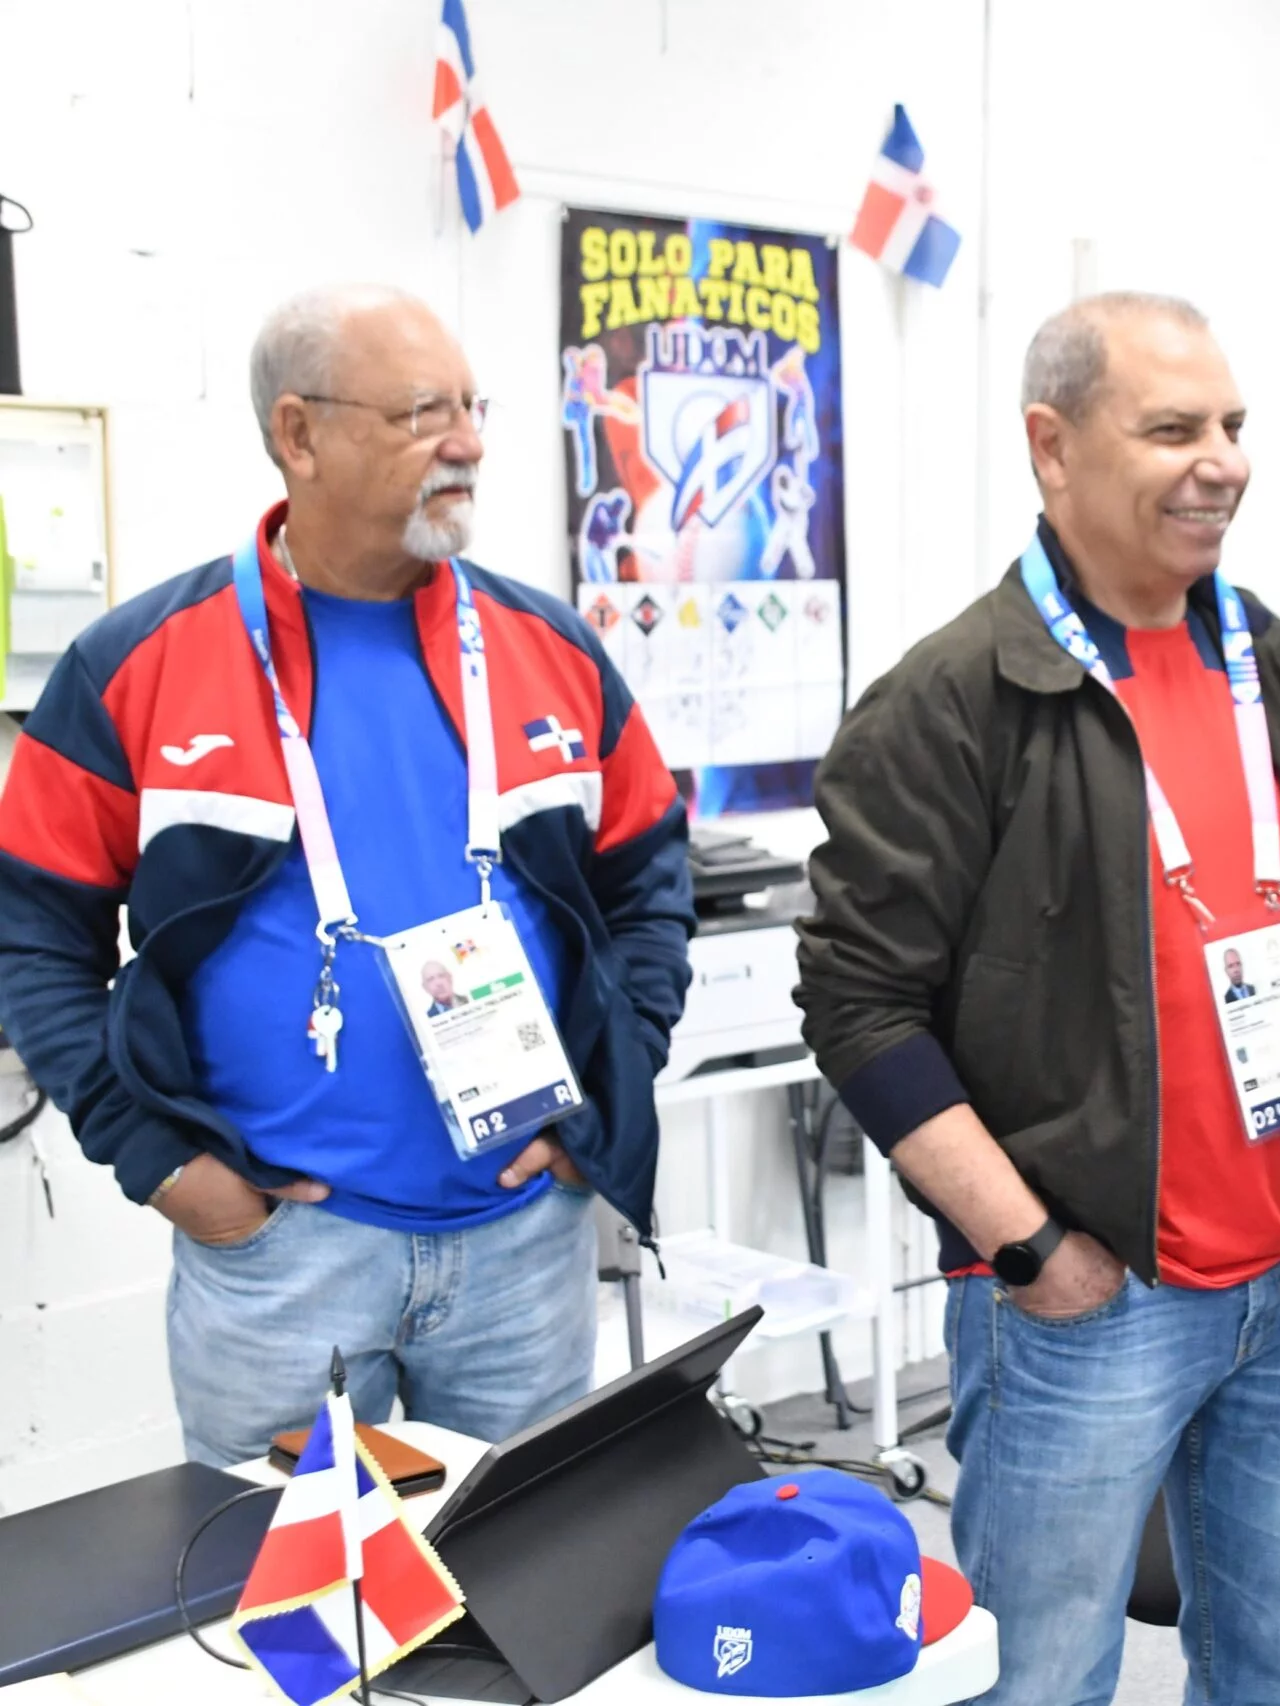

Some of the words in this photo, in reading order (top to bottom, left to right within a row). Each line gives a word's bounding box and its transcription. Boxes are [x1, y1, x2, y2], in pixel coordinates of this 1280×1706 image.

[580, 227, 693, 281] SOLO
[708, 239, 819, 303] PARA
[579, 275, 820, 354] FANATICOS
